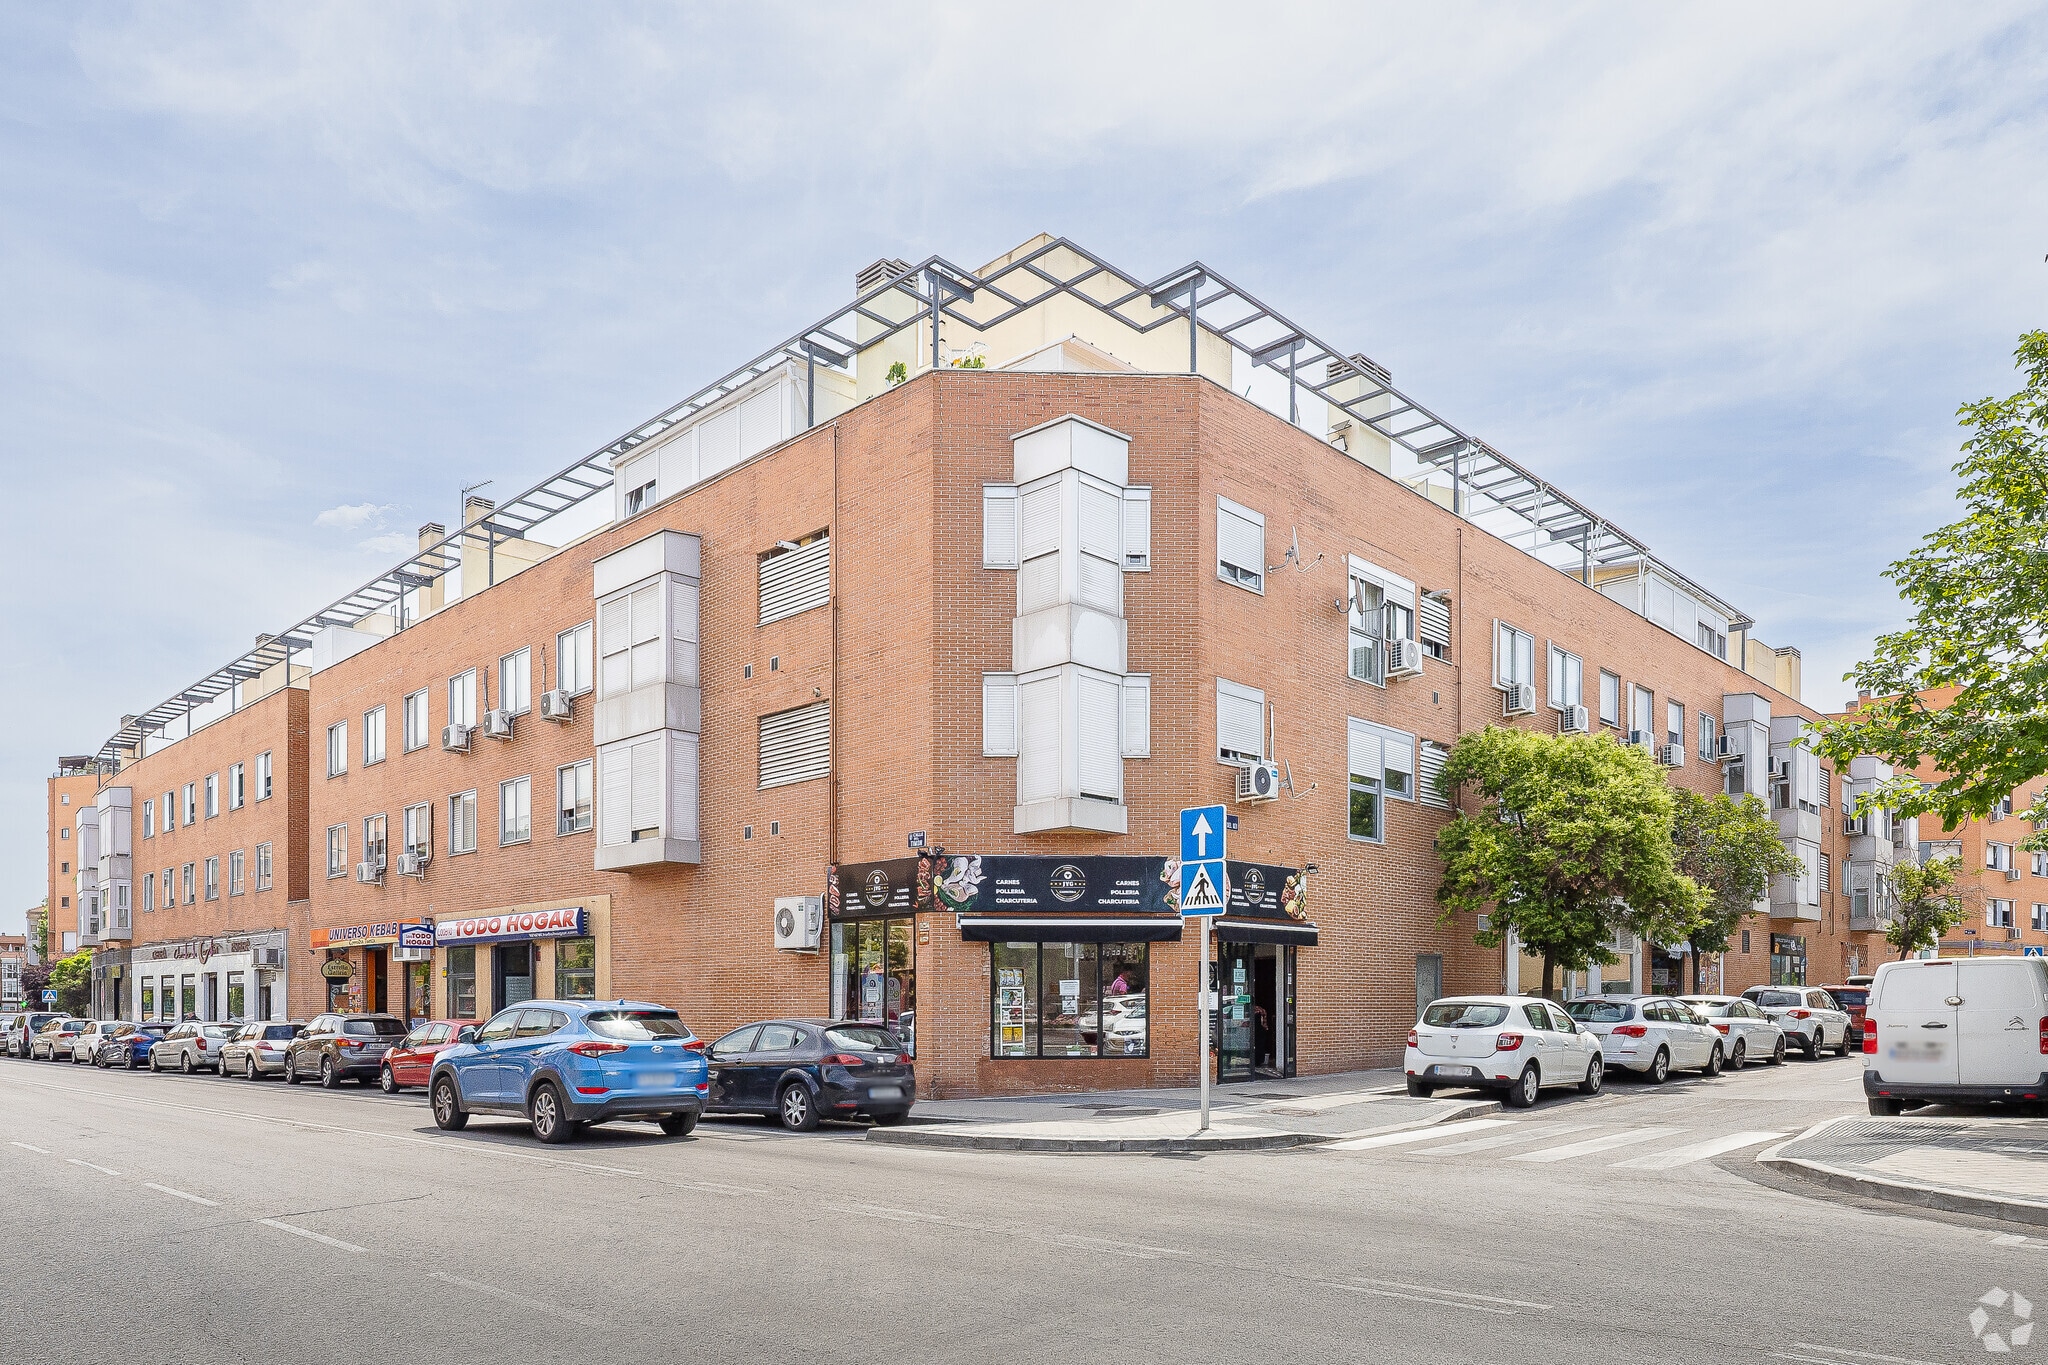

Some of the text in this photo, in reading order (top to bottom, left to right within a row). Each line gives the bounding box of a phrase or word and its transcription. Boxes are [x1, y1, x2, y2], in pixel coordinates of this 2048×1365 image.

[329, 922, 398, 941] UNIVERSO KEBAB
[455, 917, 501, 937] TODO
[506, 909, 575, 933] HOGAR
